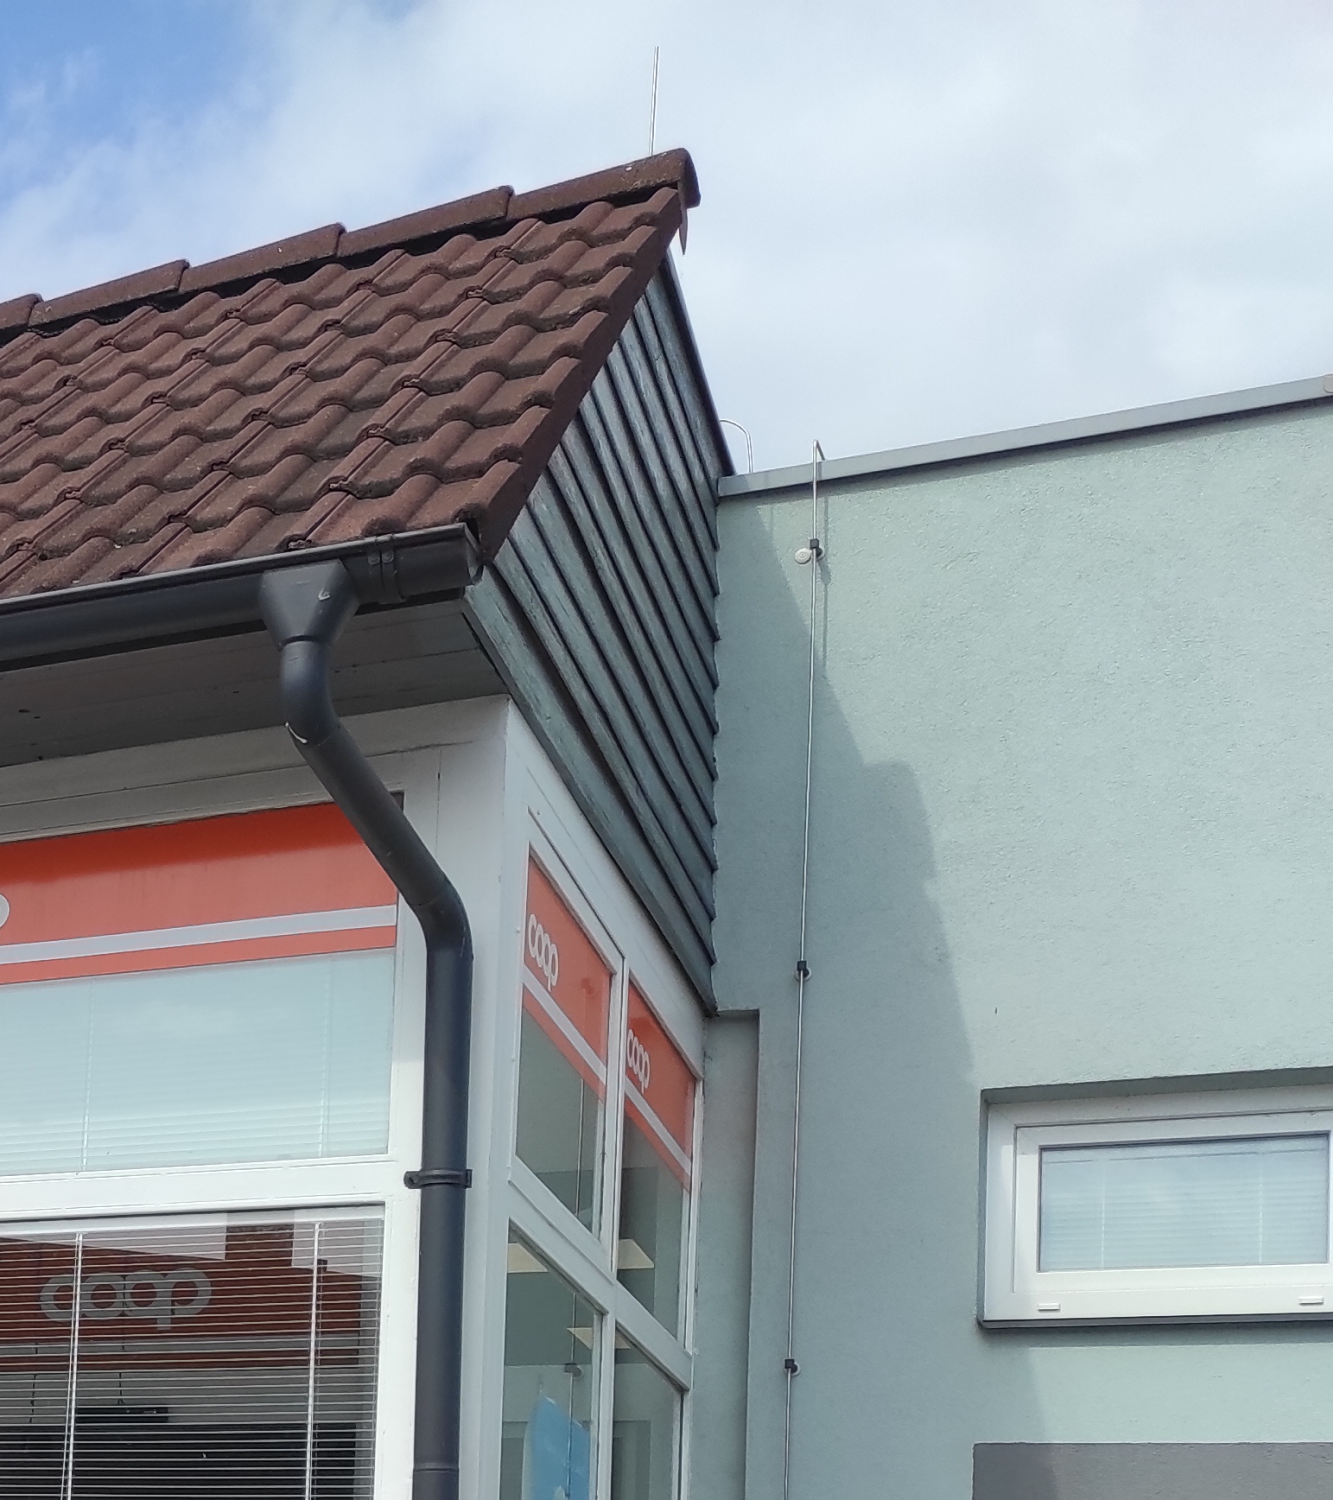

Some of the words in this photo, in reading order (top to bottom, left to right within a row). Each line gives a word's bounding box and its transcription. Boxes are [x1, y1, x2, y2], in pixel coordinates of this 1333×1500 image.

[528, 913, 559, 992] coop
[626, 1028, 650, 1094] coop
[39, 1267, 212, 1331] coop
